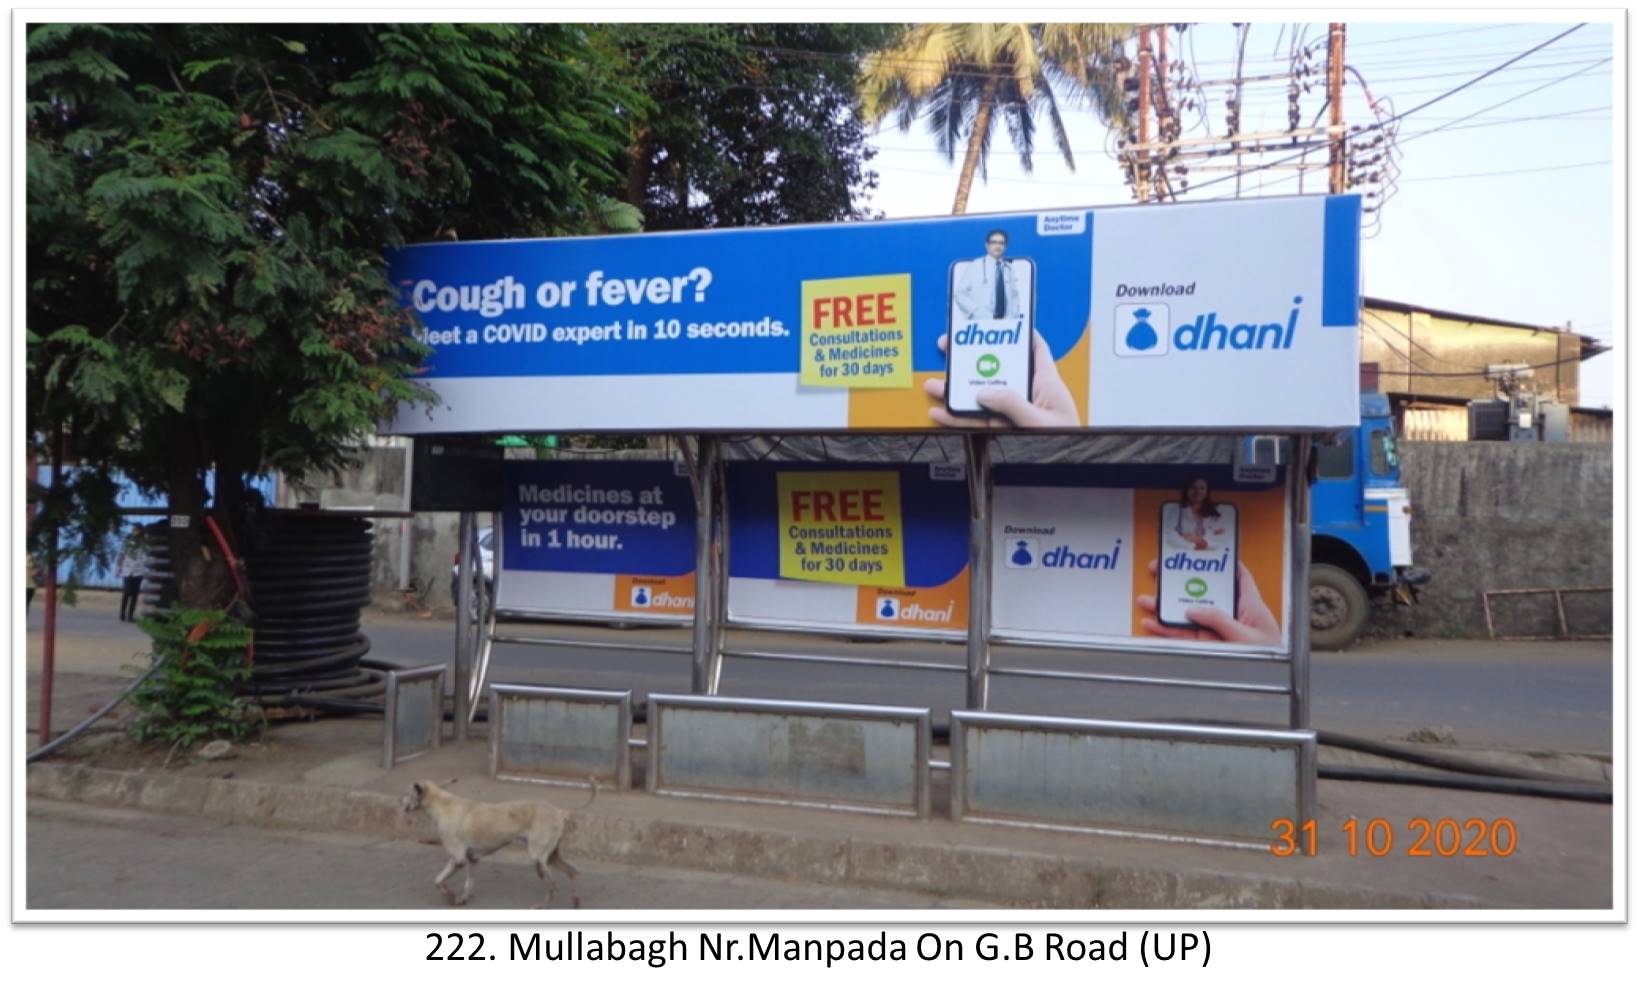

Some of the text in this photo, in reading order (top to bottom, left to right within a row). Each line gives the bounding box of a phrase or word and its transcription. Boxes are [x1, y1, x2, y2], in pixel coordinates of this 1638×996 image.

[413, 267, 713, 317] Cough or fever?
[1115, 281, 1197, 298] Download
[812, 292, 898, 329] FREE
[465, 329, 478, 345] a
[483, 322, 547, 344] COVID
[553, 320, 621, 345] expert
[627, 319, 648, 341] in
[654, 318, 681, 340] 10
[687, 316, 790, 339] seconds.
[954, 313, 1025, 346] dhani
[1173, 295, 1303, 351] dhani
[809, 327, 904, 347] Consultations
[814, 345, 899, 362] & Medicines
[819, 361, 895, 378] for 30 days
[518, 484, 664, 506] Medicines at
[790, 489, 886, 522] FREE
[520, 504, 676, 530] your doorstep
[521, 528, 624, 550] in 1 hour.
[788, 525, 893, 539] Consultations
[1003, 525, 1056, 536] Download
[795, 540, 889, 556] & Medicines
[1041, 538, 1123, 571] dhani
[801, 557, 883, 574] for 30 days
[1164, 547, 1230, 573] dhani
[901, 599, 955, 623] dhani
